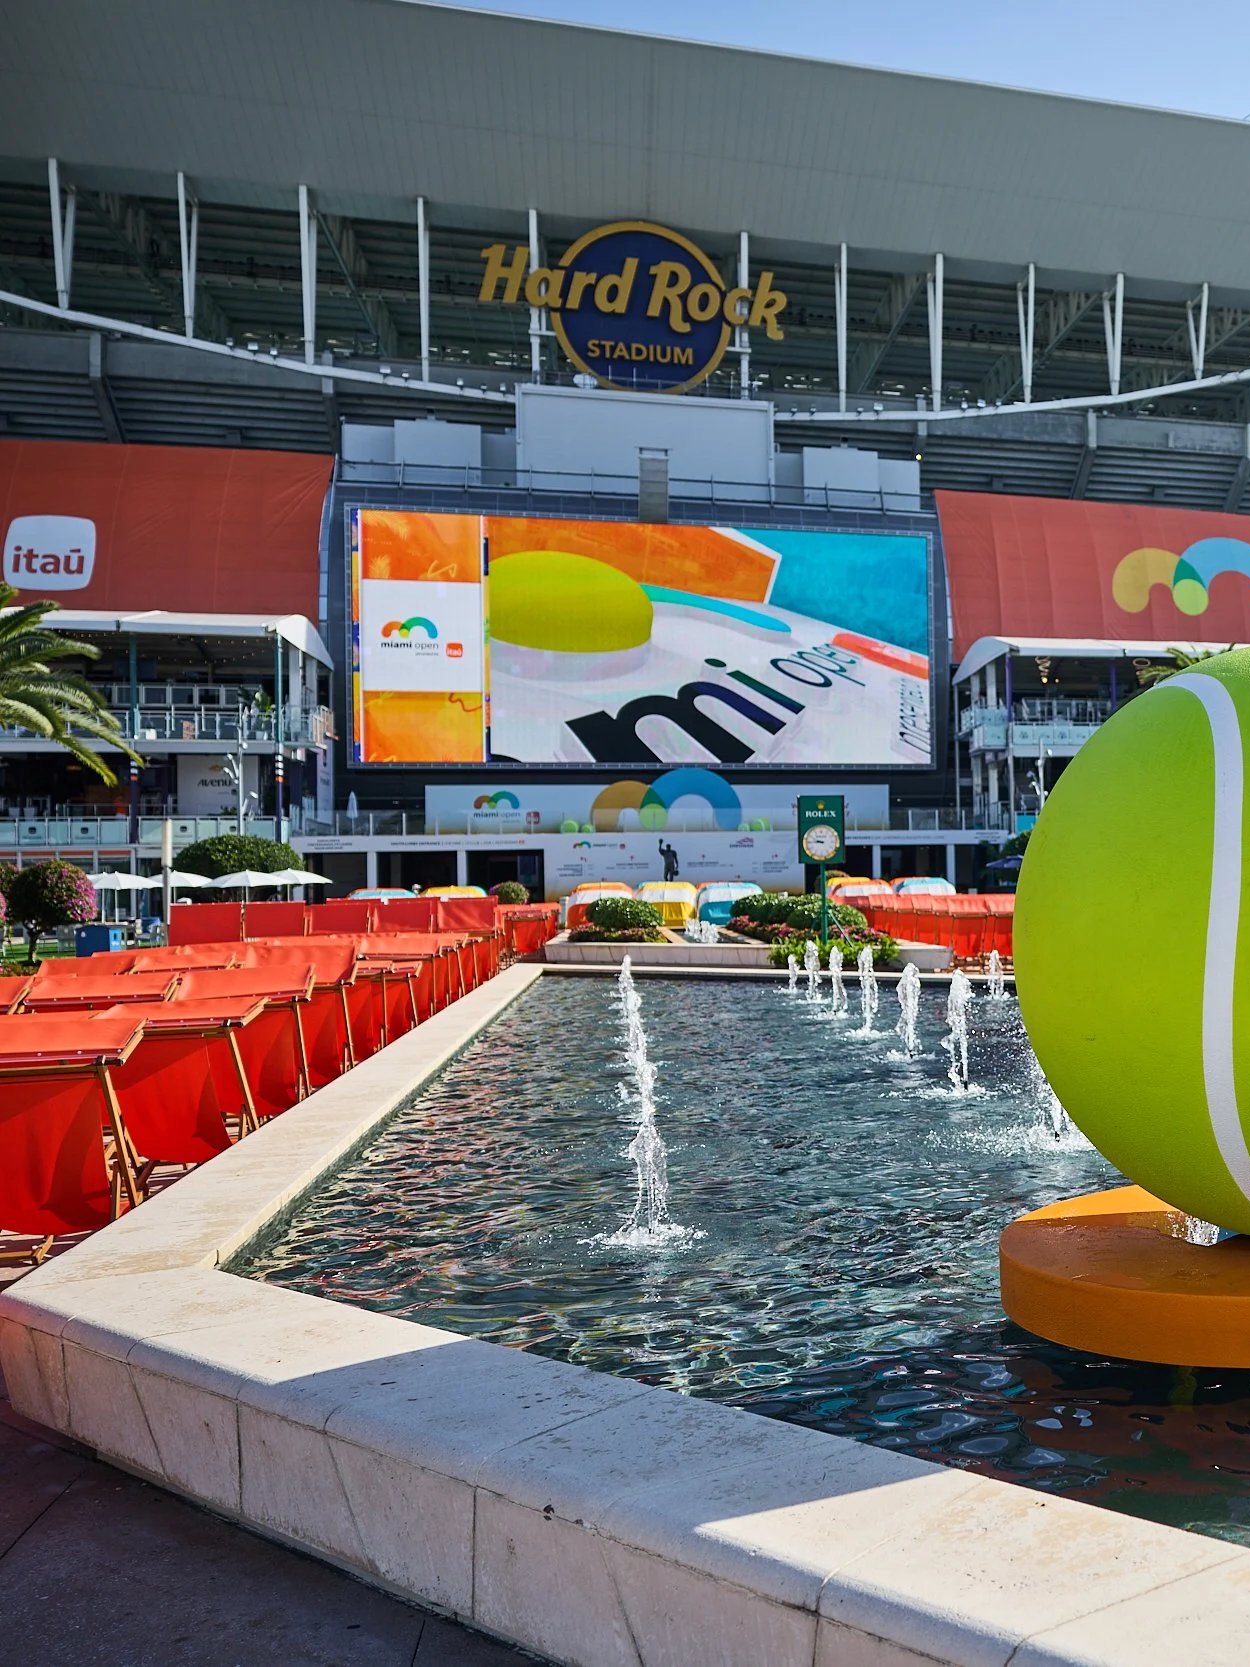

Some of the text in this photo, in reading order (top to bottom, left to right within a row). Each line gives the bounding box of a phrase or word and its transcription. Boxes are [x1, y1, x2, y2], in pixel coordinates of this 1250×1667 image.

[478, 244, 787, 341] Hard Rock
[587, 339, 693, 365] STADIUM
[12, 545, 84, 575] itaú
[380, 641, 439, 650] miami open
[492, 658, 806, 763] mi
[473, 811, 499, 819] miami
[805, 810, 836, 818] ROLEX
